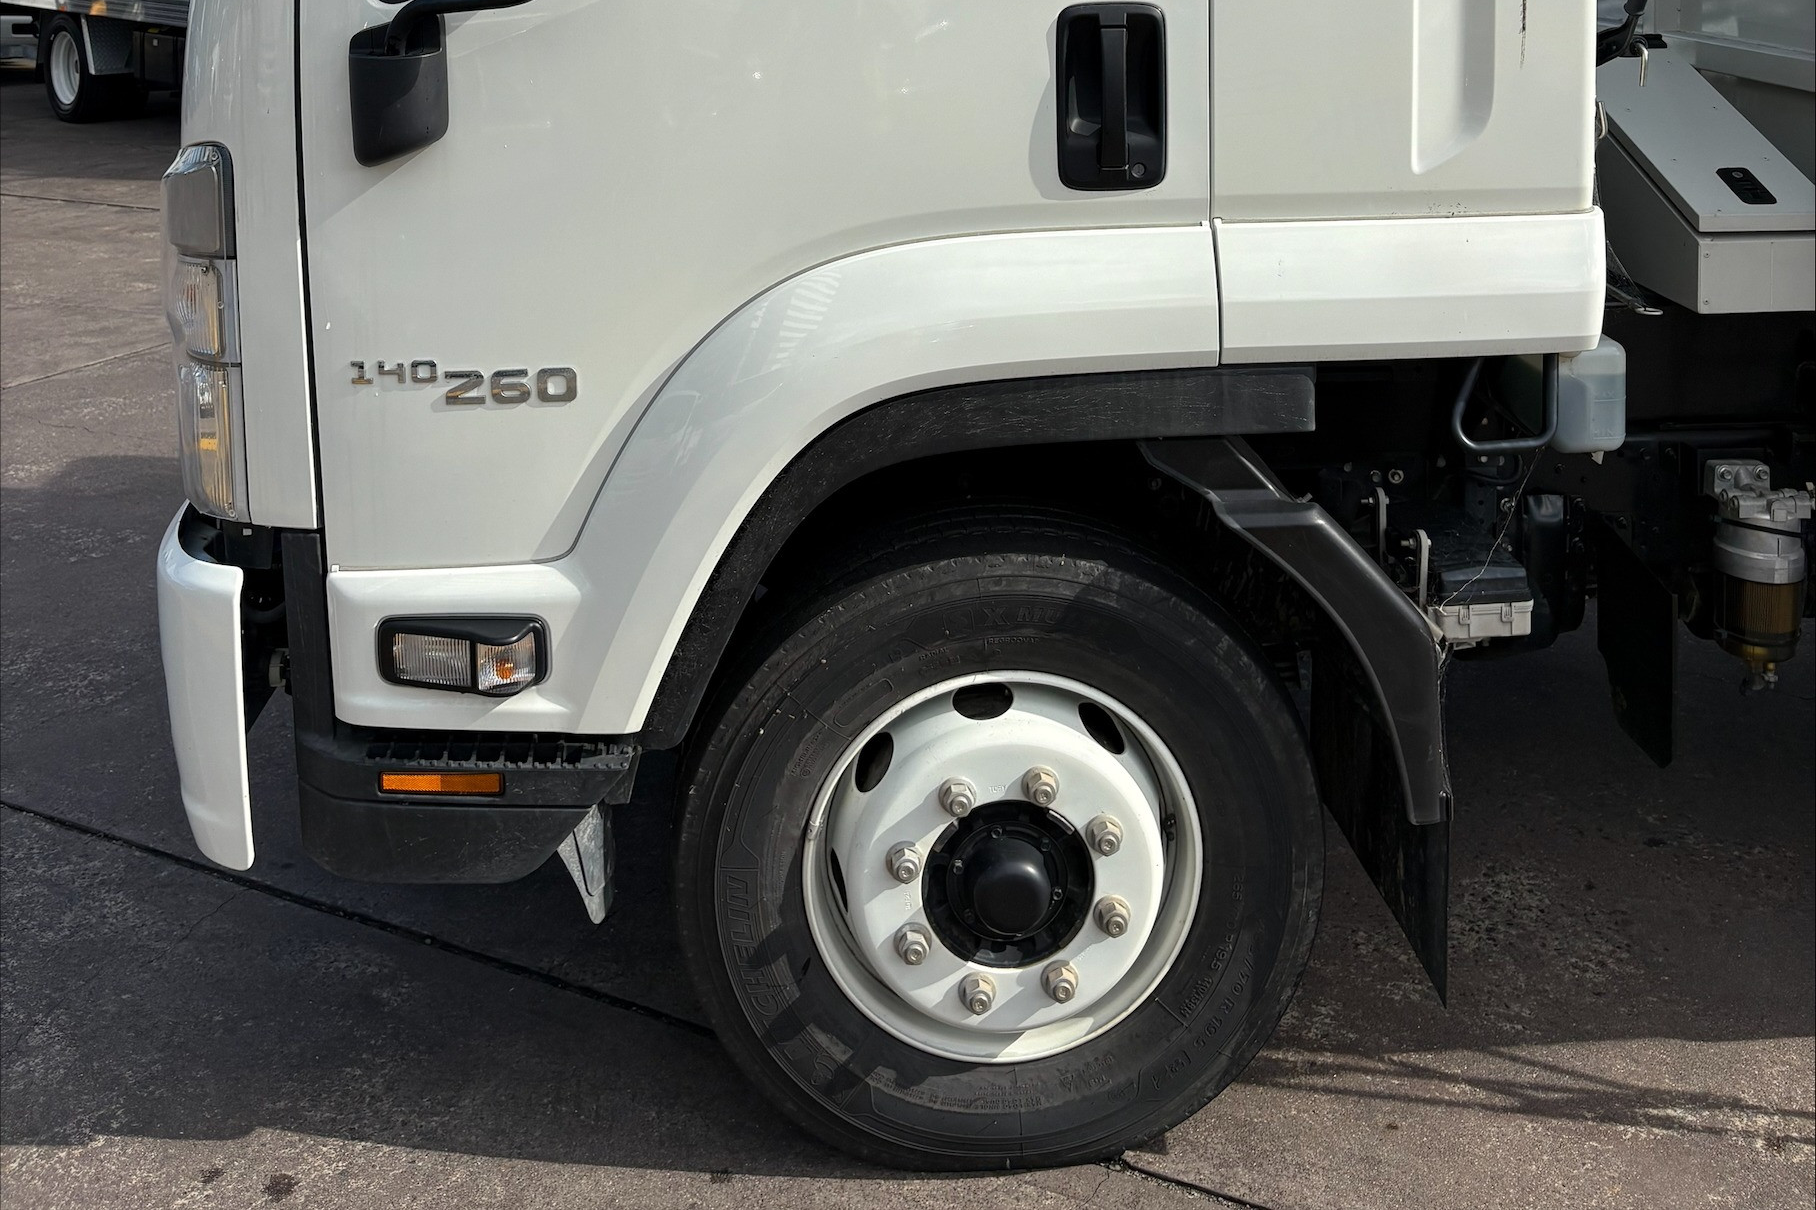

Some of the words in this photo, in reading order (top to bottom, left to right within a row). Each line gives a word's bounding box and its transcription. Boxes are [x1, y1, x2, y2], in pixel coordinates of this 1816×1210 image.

[350, 360, 438, 384] 140
[445, 367, 578, 405] 260
[725, 875, 813, 1062] MCHELIN
